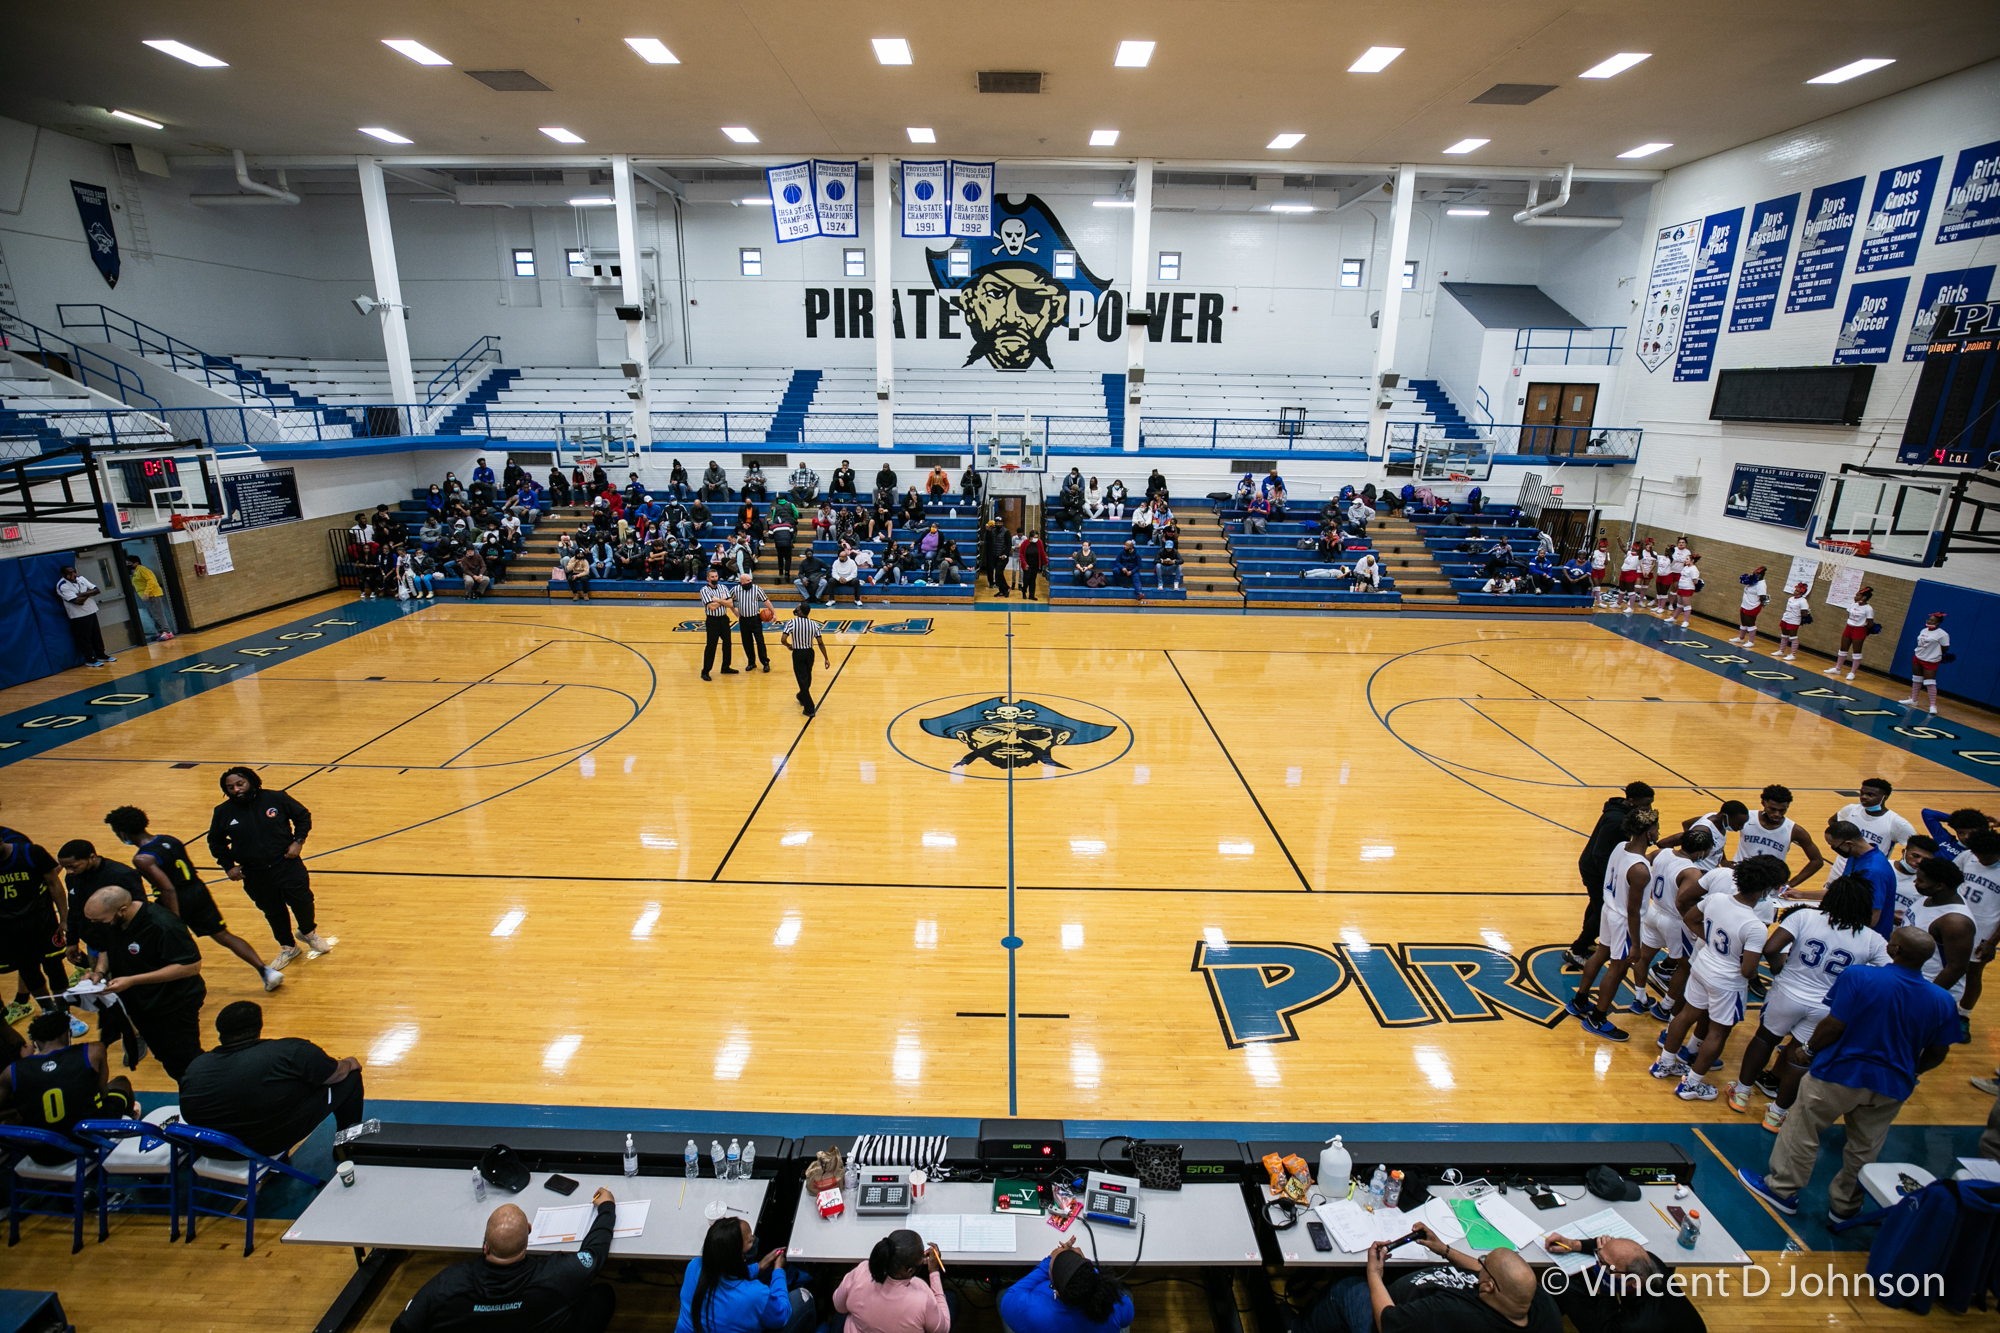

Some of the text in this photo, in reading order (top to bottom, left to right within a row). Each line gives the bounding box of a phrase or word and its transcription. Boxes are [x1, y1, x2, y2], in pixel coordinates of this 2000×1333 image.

[772, 166, 807, 178] PROVISO EAST
[783, 173, 808, 182] BASKETBALL
[1892, 169, 1922, 189] Boys
[1821, 197, 1846, 215] Boys
[1885, 190, 1919, 210] Cross
[778, 204, 812, 217] IHSA STATE
[819, 203, 854, 212] IHSA STATE
[908, 204, 922, 212] IHSA
[955, 204, 968, 212] IHSA
[780, 212, 814, 224] CHAMPIONS
[819, 211, 854, 220] CHAMPIONS
[908, 212, 943, 220] CHAMPIONS
[954, 212, 989, 221] CHAMPIONS
[1762, 212, 1783, 228] Boys
[1873, 208, 1921, 232] Country
[789, 223, 809, 235] 1969
[826, 222, 846, 232] 1974
[916, 222, 935, 232] 1991
[961, 223, 982, 232] 1992
[1712, 225, 1730, 239] Boys
[1804, 213, 1854, 238] Gymnastics
[1944, 222, 1971, 233] REGIONAL
[1751, 224, 1788, 246] Baseball
[1866, 232, 1917, 247] REGIONAL CHAMPION
[1708, 240, 1729, 256] Track
[1801, 245, 1845, 258] REGIONAL CHAMPION
[1869, 254, 1883, 263] FIRST
[1889, 251, 1905, 259] STATE
[1821, 262, 1834, 270] STATE
[1937, 284, 1969, 305] Girls
[1861, 295, 1888, 314] Boys
[1851, 315, 1889, 332] Soccer
[1838, 347, 1886, 356] REGIONAL CHAMPION
[1928, 340, 1992, 354] player points
[1935, 449, 1946, 464] 4
[1797, 472, 1822, 480] SCHOOL
[4, 527, 19, 539] EXIT
[173, 618, 361, 674] EAST
[1744, 834, 1785, 852] PIRATES
[4, 885, 18, 899] 15
[1654, 874, 1665, 899] 0
[1964, 886, 1984, 904] 15
[1706, 918, 1731, 956] 13
[1800, 938, 1855, 977] 32
[42, 1088, 65, 1123] 0
[1186, 1165, 1224, 1174] SMG
[1629, 1167, 1668, 1176] SMG
[1020, 1189, 1036, 1201] V
[473, 1301, 523, 1312] #ADIDASLEGACY
